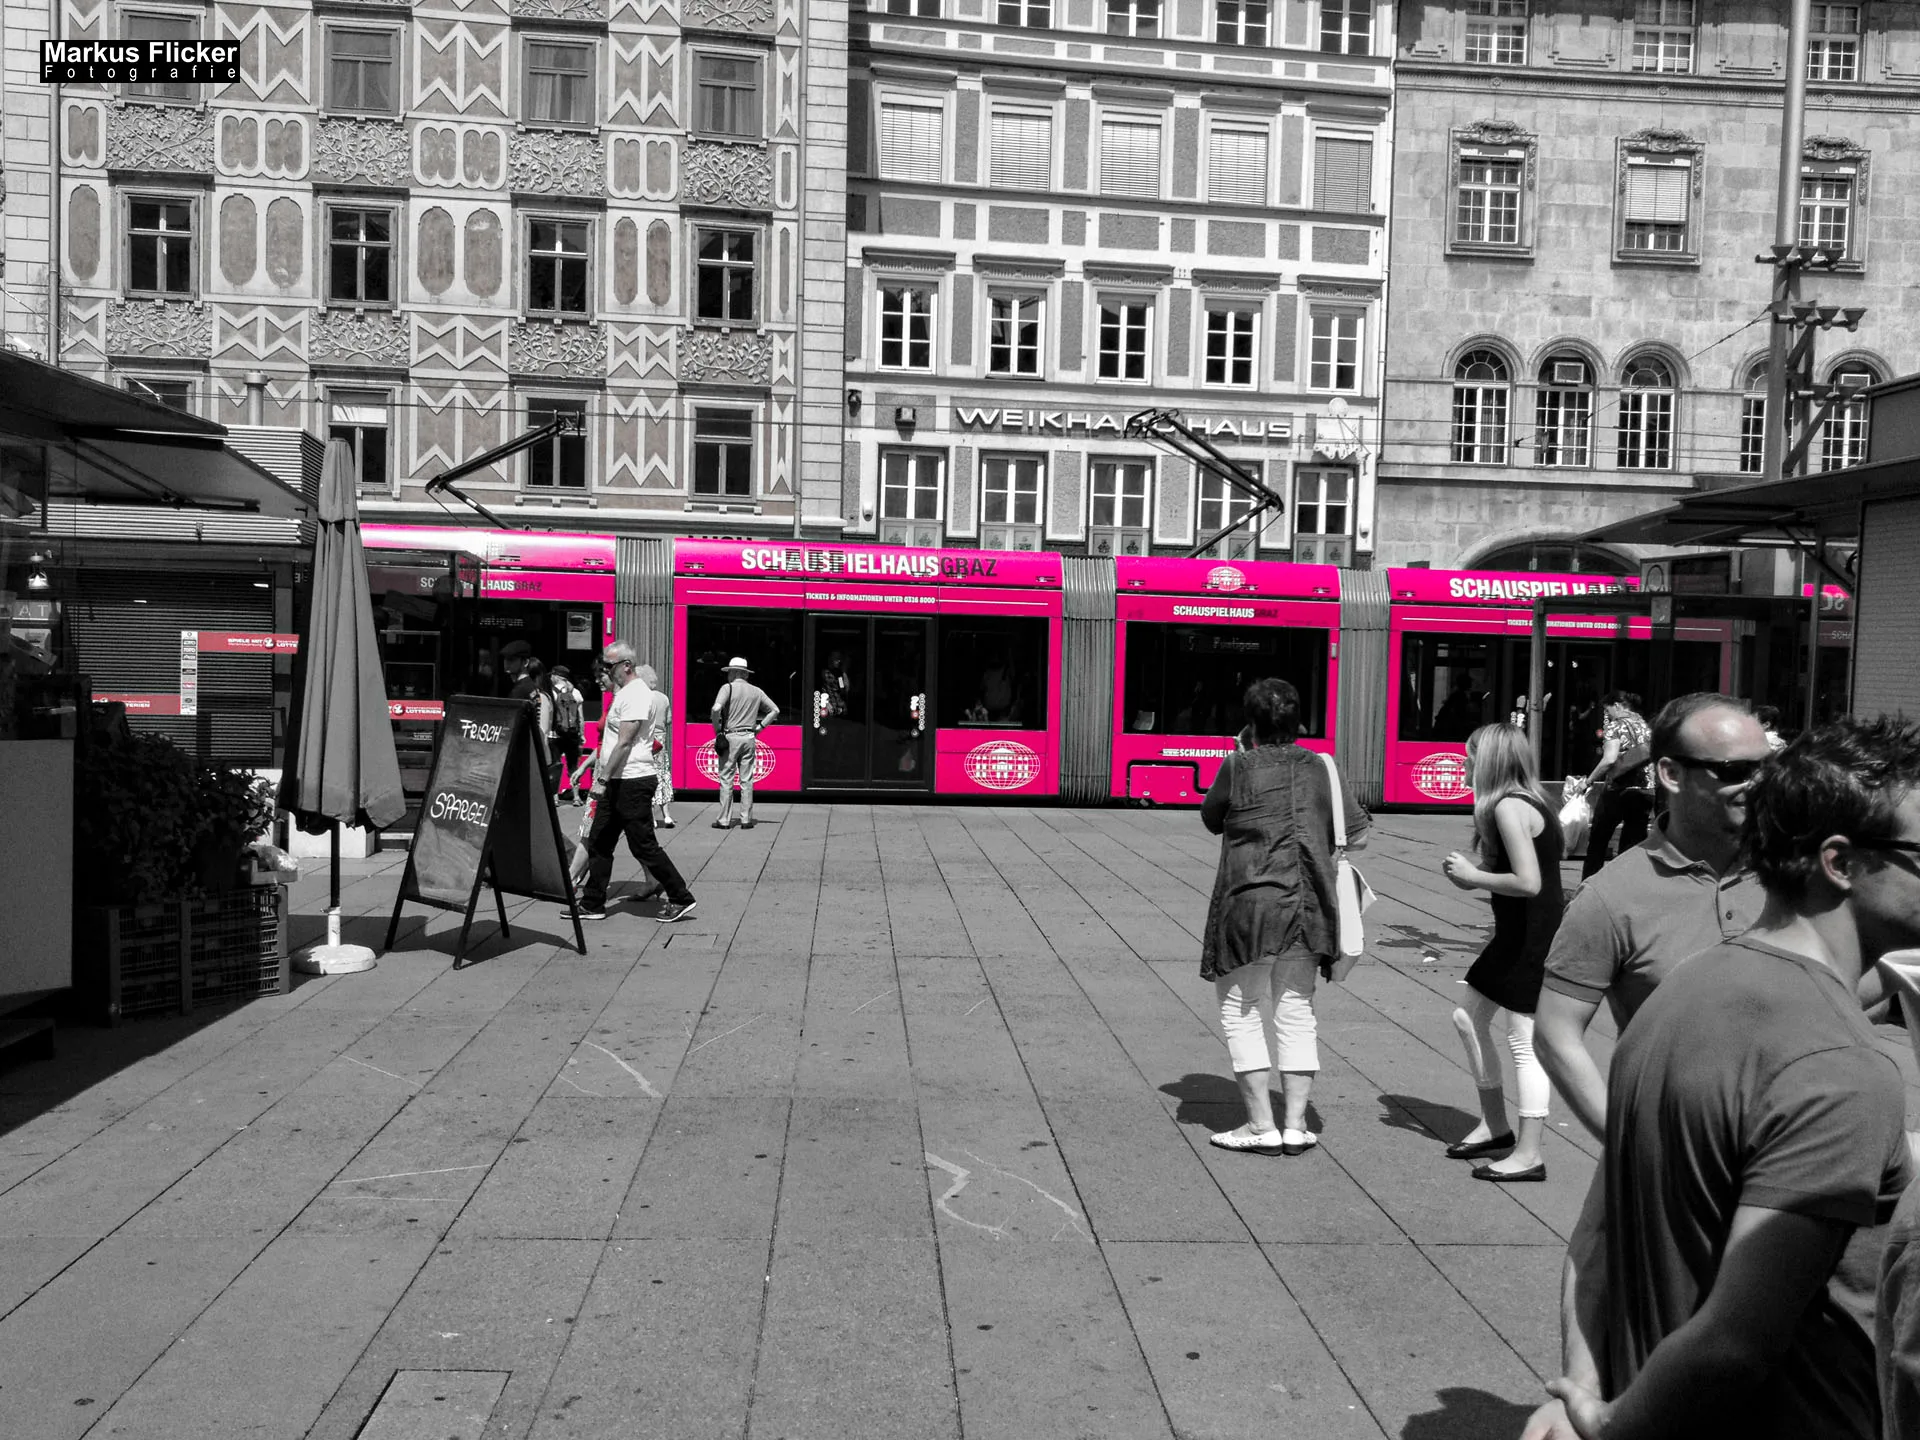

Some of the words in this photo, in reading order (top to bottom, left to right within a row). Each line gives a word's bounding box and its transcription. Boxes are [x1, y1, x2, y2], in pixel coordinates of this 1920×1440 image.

[1187, 417, 1292, 438] HAUS
[805, 592, 829, 601] TICKETS
[459, 719, 502, 743] FRISCH
[430, 792, 488, 827] SPARGEL
